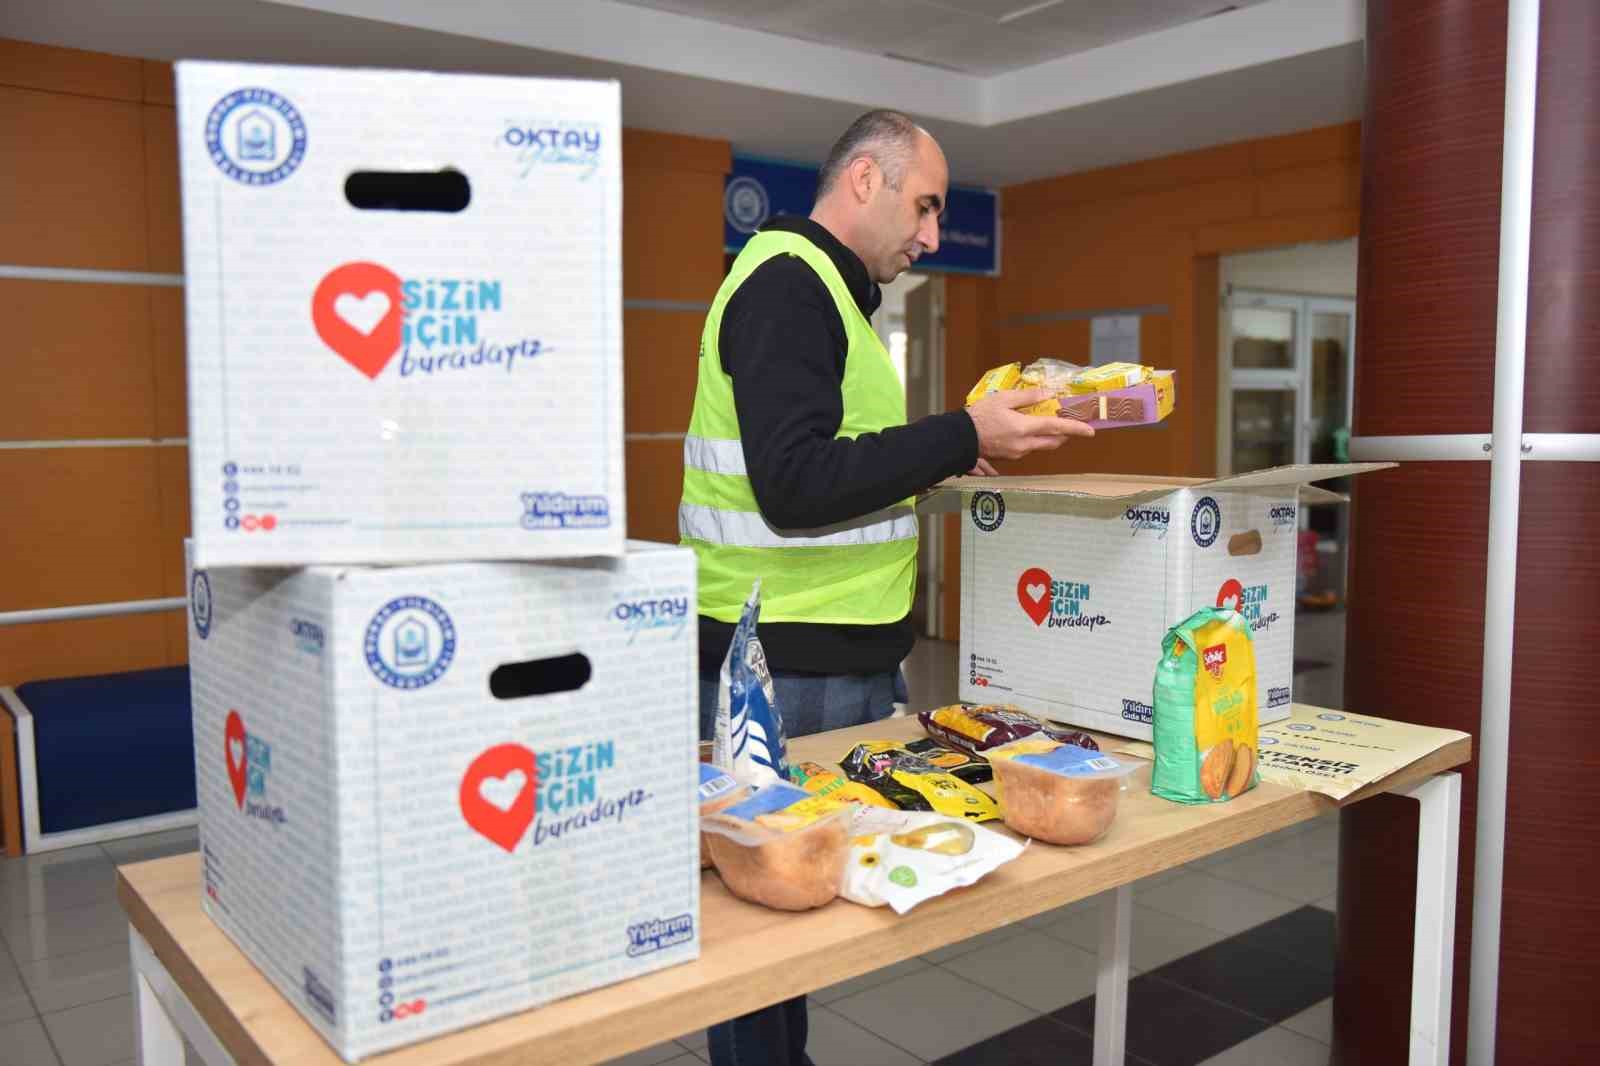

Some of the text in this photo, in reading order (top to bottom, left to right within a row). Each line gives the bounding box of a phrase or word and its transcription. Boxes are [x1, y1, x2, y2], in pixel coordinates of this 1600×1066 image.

[504, 127, 601, 152] OKTAY
[1126, 508, 1170, 524] OKTAY
[616, 596, 688, 620] OKTAY
